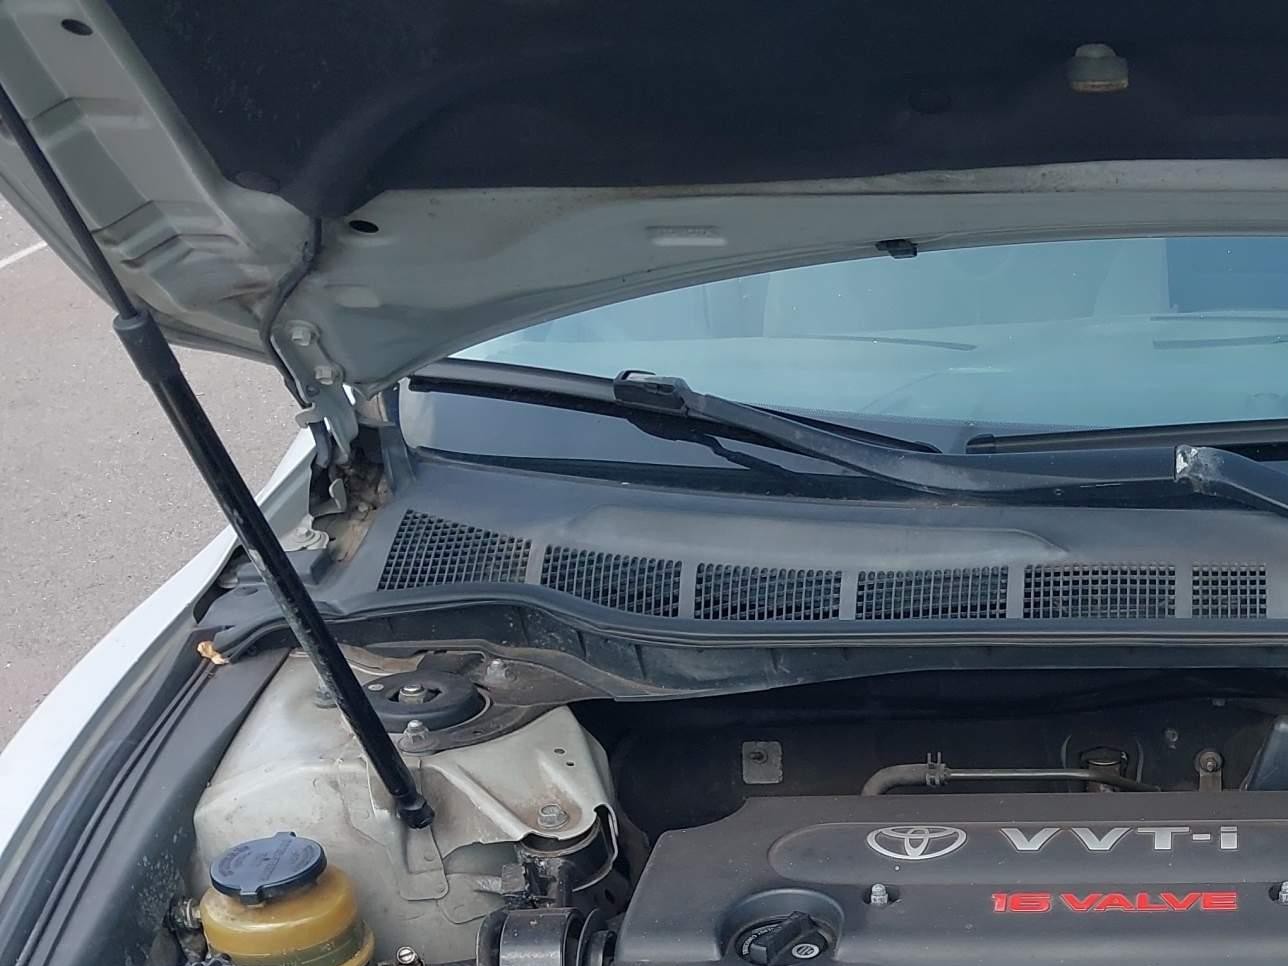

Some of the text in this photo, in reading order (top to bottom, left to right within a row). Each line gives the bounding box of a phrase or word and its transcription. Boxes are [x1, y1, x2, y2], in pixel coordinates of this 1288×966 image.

[1000, 826, 1239, 850] VVT-i
[992, 891, 1240, 913] 16 VALVE
